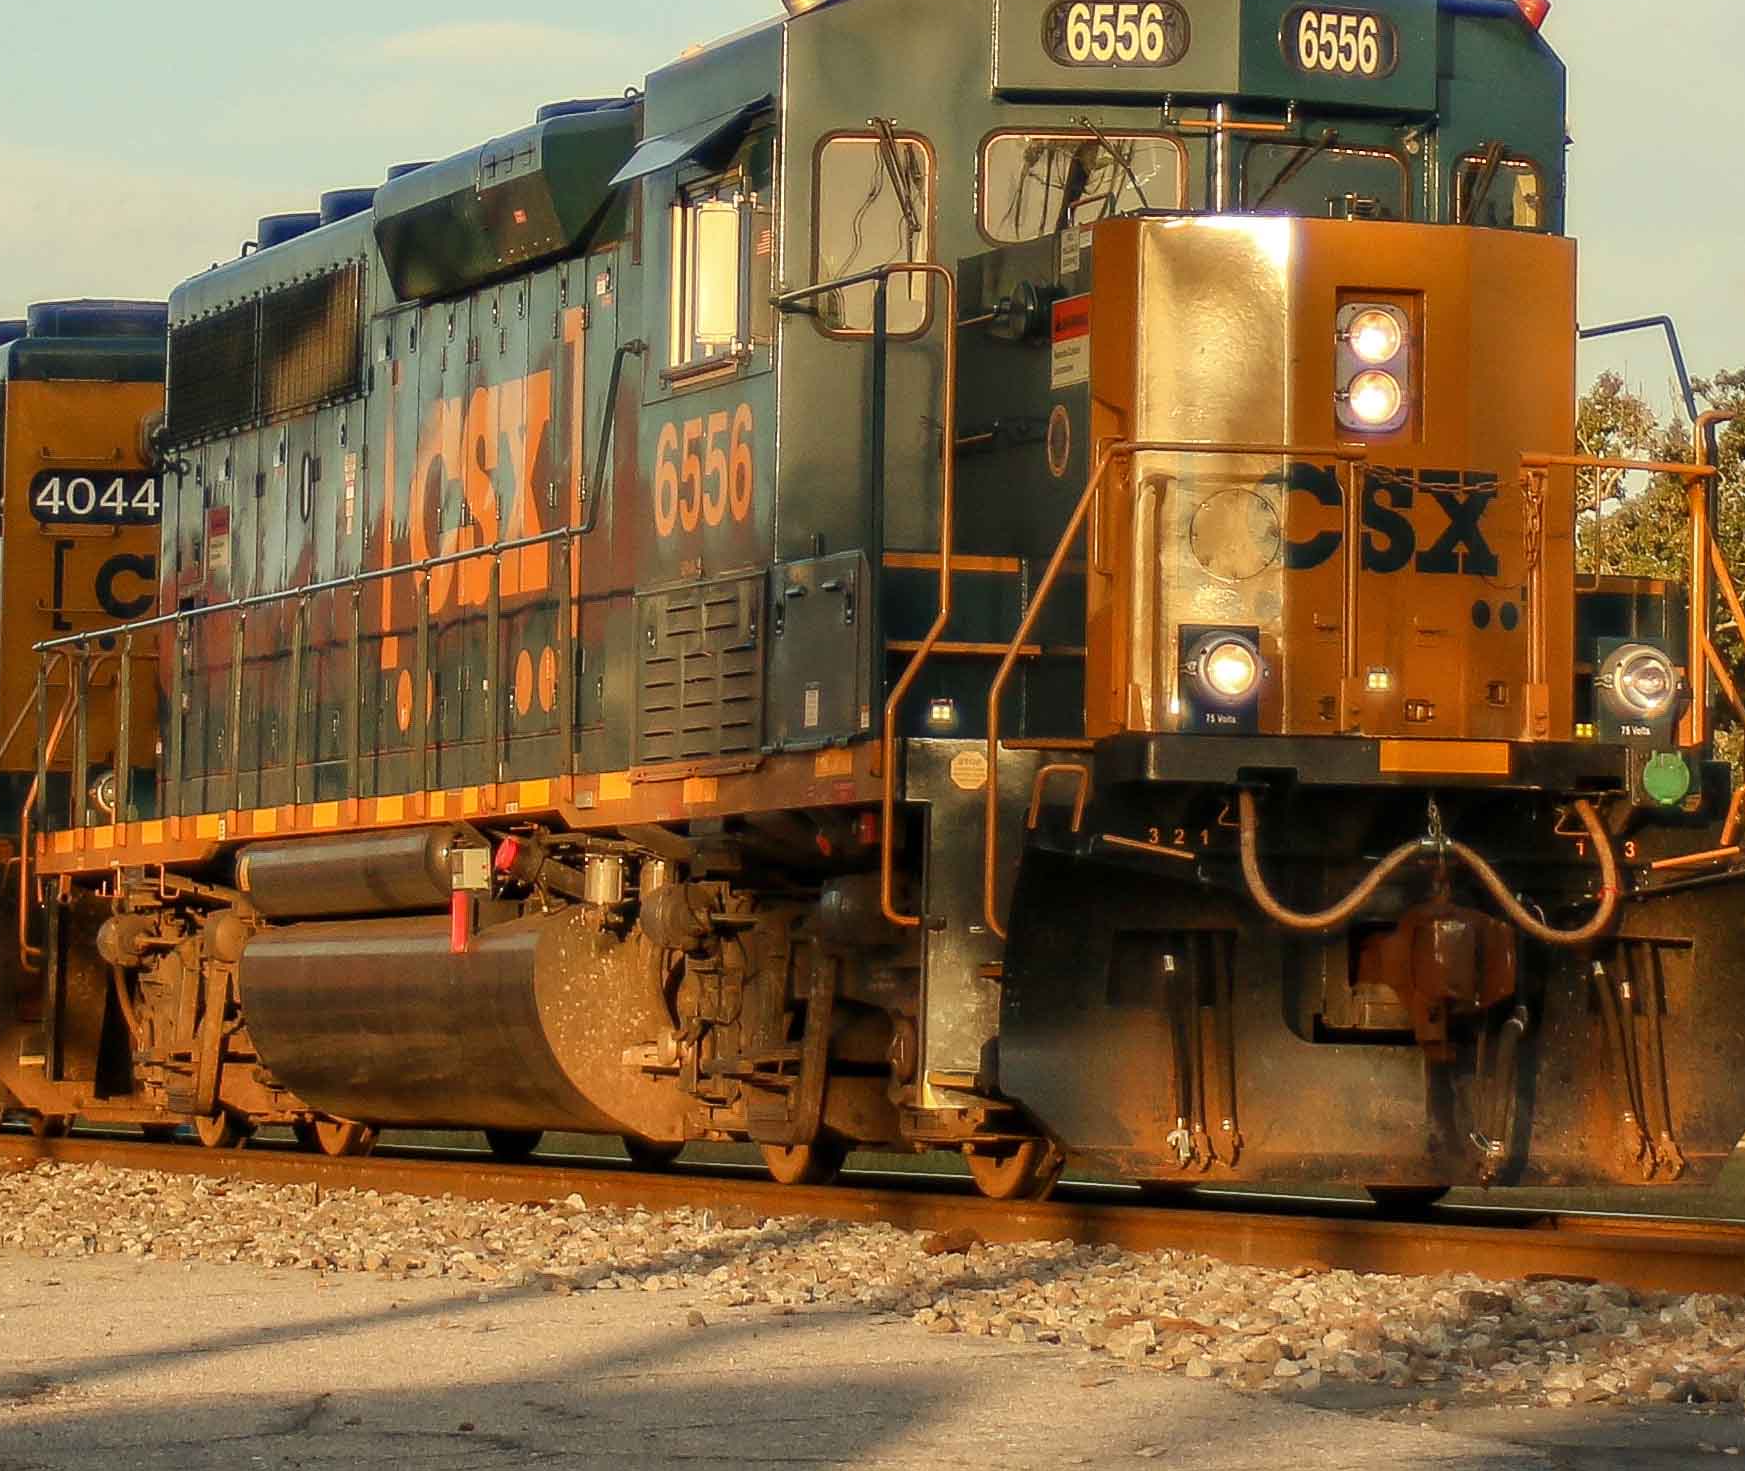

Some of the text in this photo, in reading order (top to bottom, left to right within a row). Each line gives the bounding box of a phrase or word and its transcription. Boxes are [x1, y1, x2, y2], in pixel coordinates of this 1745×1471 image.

[1066, 2, 1165, 62] 6556
[1298, 10, 1379, 74] 6556
[35, 477, 161, 516] 4044
[655, 402, 754, 537] 6556
[1260, 461, 1499, 577] CSX
[1149, 827, 1209, 845] 3 2 1
[1624, 841, 1635, 858] 3
